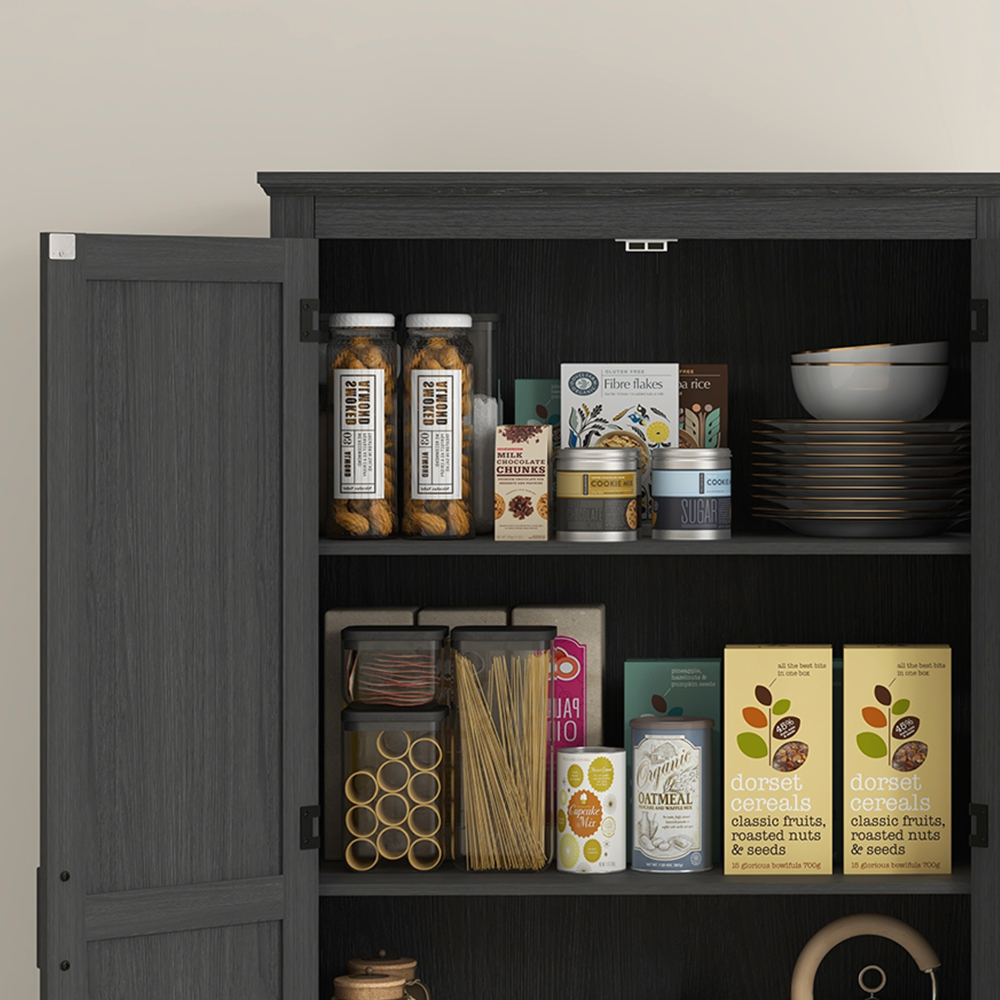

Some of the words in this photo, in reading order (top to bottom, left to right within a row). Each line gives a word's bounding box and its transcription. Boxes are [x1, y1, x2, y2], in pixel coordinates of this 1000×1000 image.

[604, 378, 630, 389] Fibre
[634, 378, 663, 389] flakes
[691, 378, 711, 389] rice
[681, 499, 718, 524] SUGAR
[636, 750, 691, 789] Organic
[731, 774, 803, 791] dorset
[850, 773, 922, 791] dorset
[638, 792, 693, 805] OATMEAL
[731, 794, 811, 812] cereals
[850, 794, 931, 812] cereals
[569, 806, 600, 820] Cupcake
[580, 816, 596, 828] Mix
[731, 815, 779, 827] classic
[783, 815, 826, 829] fruits,
[851, 815, 899, 827] classic
[902, 815, 946, 828] fruits,
[731, 830, 785, 841] roasted
[789, 830, 821, 841] nuts
[851, 829, 904, 840] roasted
[908, 830, 940, 840] nuts
[731, 844, 743, 856] &
[747, 844, 786, 856] seeds
[851, 844, 863, 855] &
[866, 844, 905, 855] seeds
